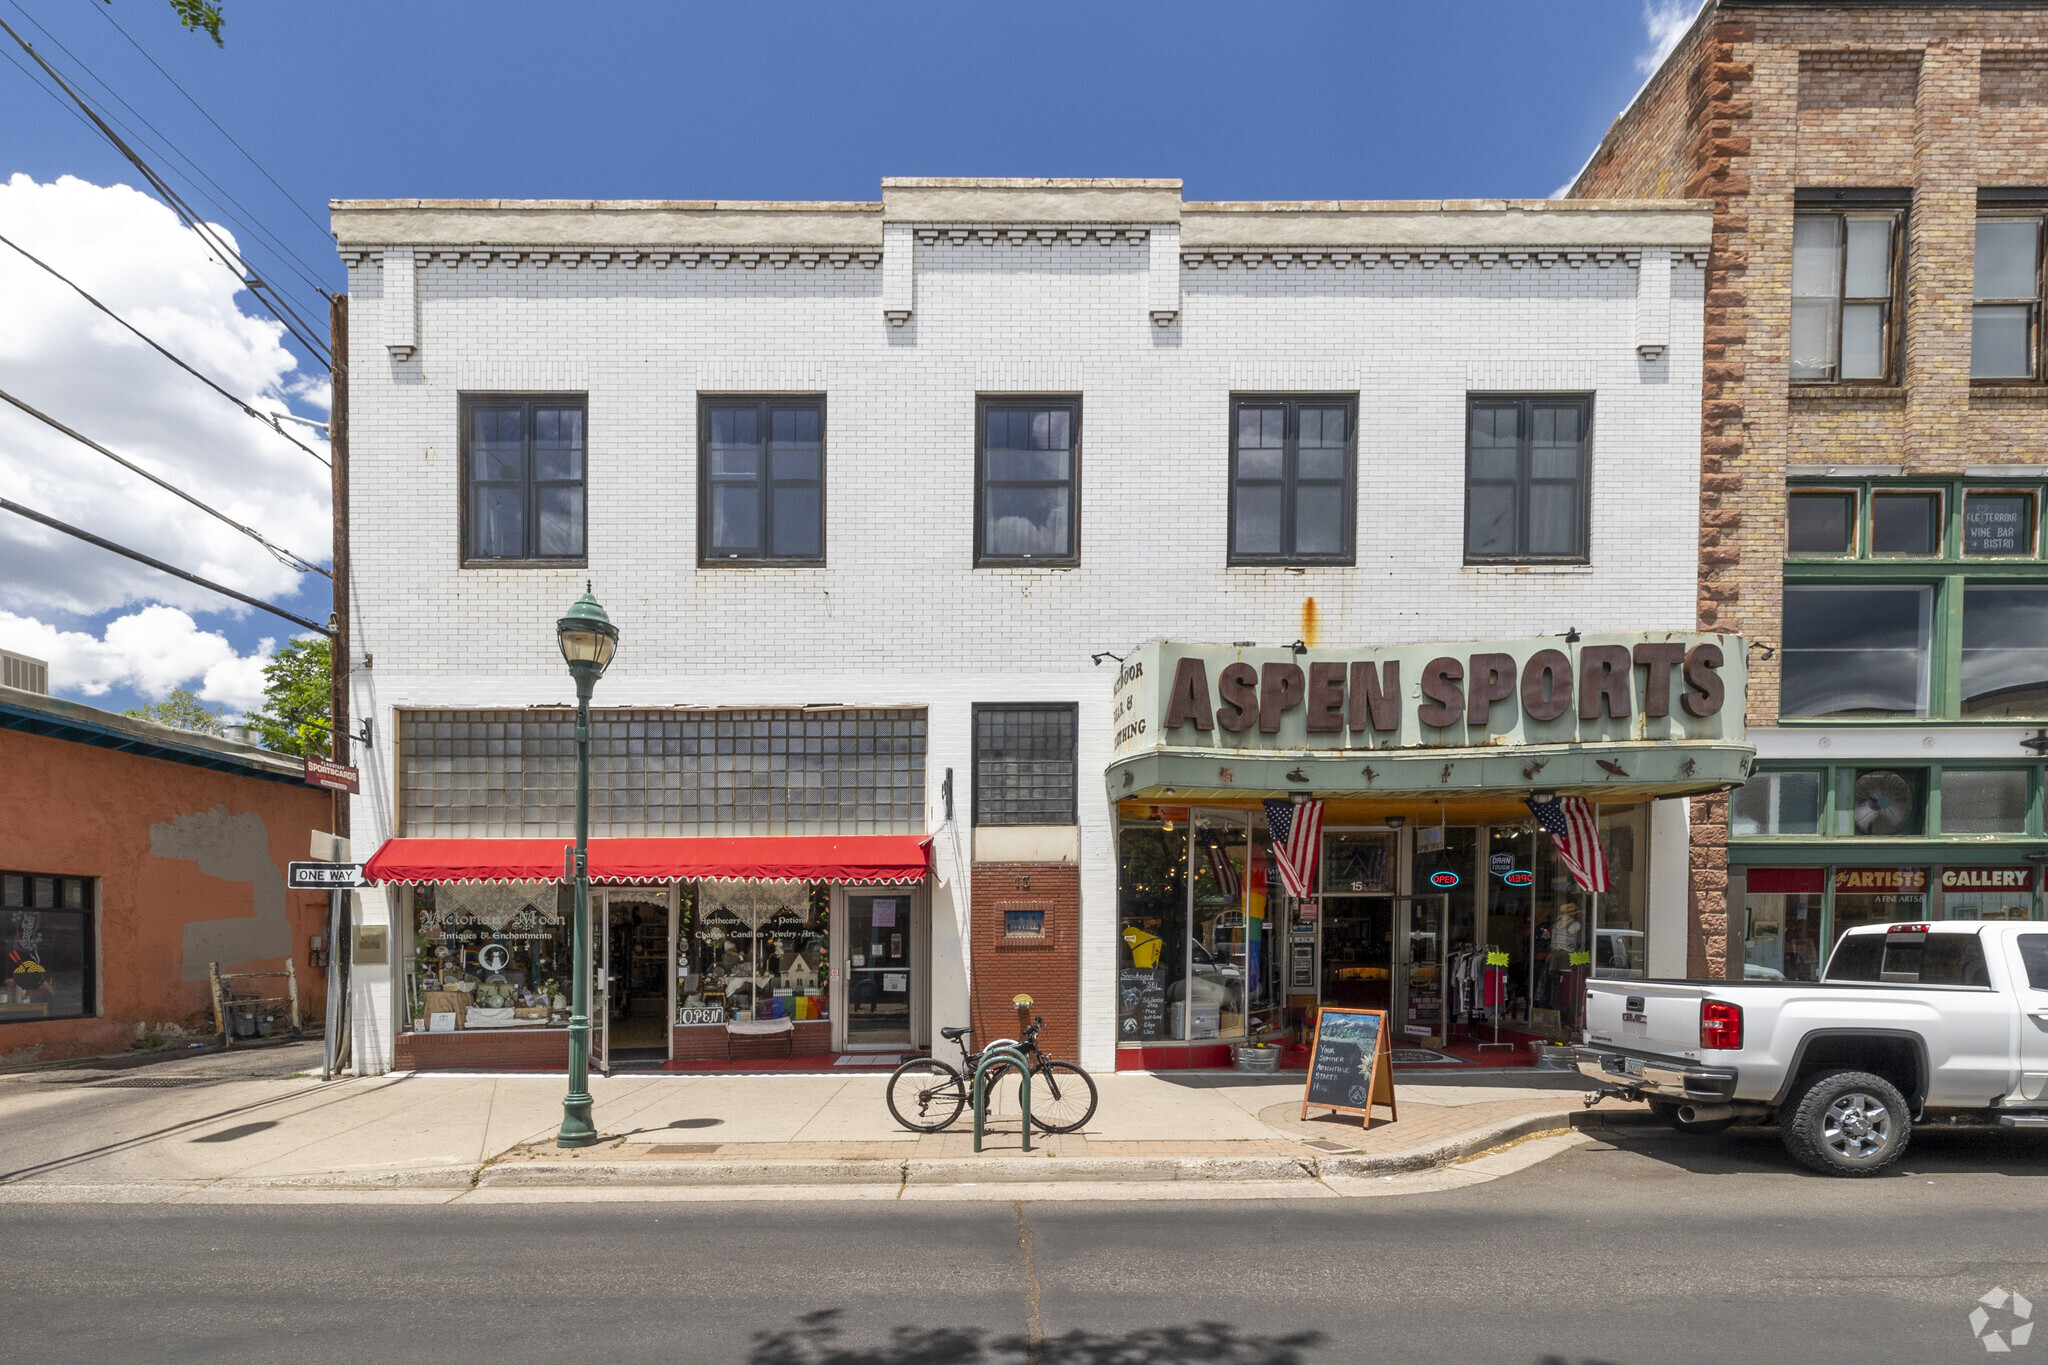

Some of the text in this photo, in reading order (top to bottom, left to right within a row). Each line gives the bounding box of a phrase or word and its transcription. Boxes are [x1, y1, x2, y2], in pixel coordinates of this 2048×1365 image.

[1985, 512, 2018, 523] TERROIR
[1970, 527, 2014, 537] WINE BAR
[1983, 538, 2014, 549] BISTRO
[1163, 657, 1401, 734] ASPEN
[1418, 642, 1726, 729] SPORTS
[308, 761, 357, 782] SPORTSCARDS
[299, 870, 353, 881] ONE WAY
[1432, 875, 1456, 884] OPEN
[1847, 871, 1925, 887] ARTISTS
[1942, 870, 2029, 887] GALLERY
[1015, 875, 1031, 888] 13
[1350, 881, 1363, 892] 15
[512, 909, 566, 931] Moon
[700, 917, 741, 926] Apothecary
[778, 916, 808, 926] Potions
[440, 931, 477, 941] Antiques
[492, 931, 553, 941] Enchantments
[769, 930, 797, 939] Jewelry
[1120, 970, 1155, 981] Snowboard
[682, 1009, 722, 1024] OPEN
[1622, 1012, 1648, 1024] GMC
[1318, 1054, 1344, 1063] SUMMER
[1314, 1072, 1339, 1081] STARTS
